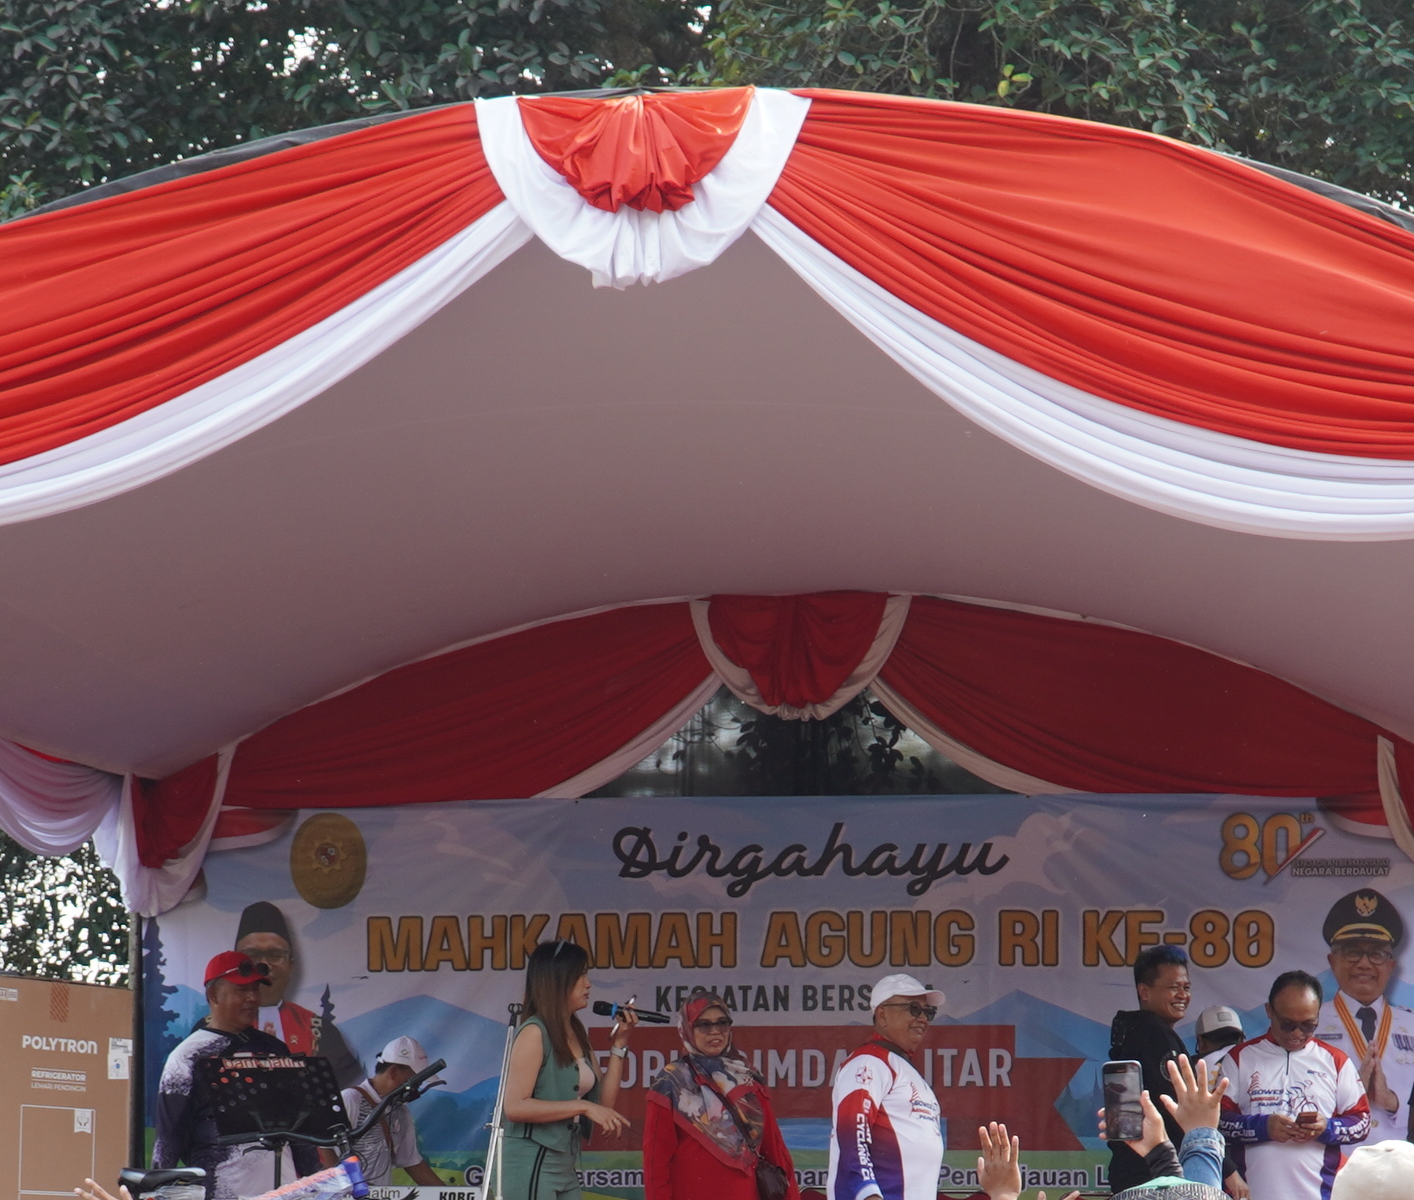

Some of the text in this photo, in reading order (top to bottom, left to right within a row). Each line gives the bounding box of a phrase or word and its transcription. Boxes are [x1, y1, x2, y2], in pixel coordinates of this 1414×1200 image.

[612, 822, 1010, 898] Dirgahayu
[1292, 867, 1390, 876] NEGARA BERDAULAT
[760, 909, 975, 968] AGUNG
[998, 910, 1059, 967] RI
[655, 984, 789, 1012] KEATAN
[31, 1070, 86, 1081] REFRIGERATOR
[923, 1048, 1012, 1088] ITAR
[937, 1164, 1087, 1191] Penjauan
